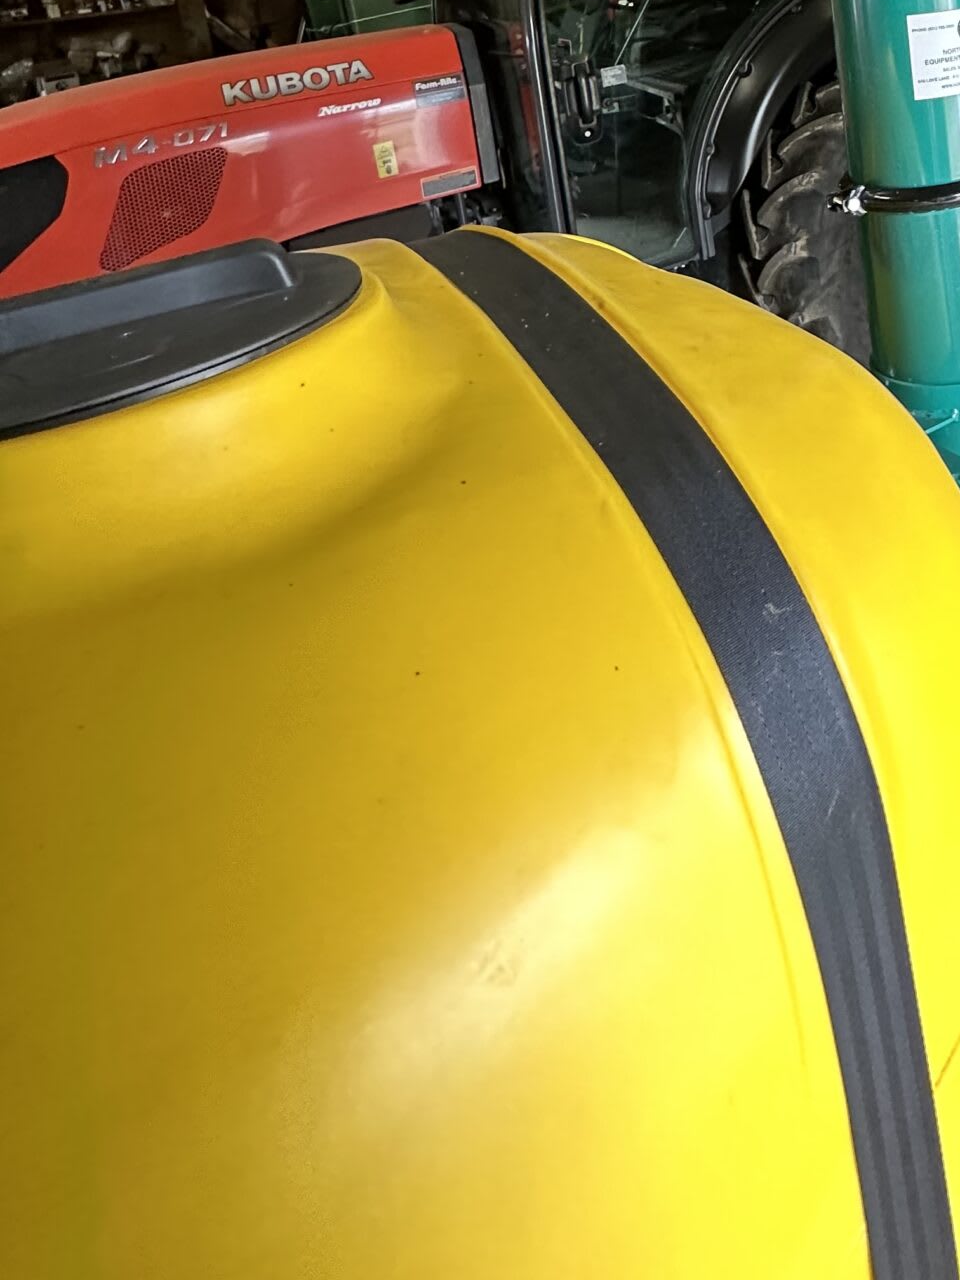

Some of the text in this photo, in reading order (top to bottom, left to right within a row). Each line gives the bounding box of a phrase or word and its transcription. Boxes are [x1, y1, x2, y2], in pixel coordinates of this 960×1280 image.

[221, 59, 374, 106] KUBOTA
[317, 97, 382, 117] Narrow
[93, 121, 229, 168] M4-071
